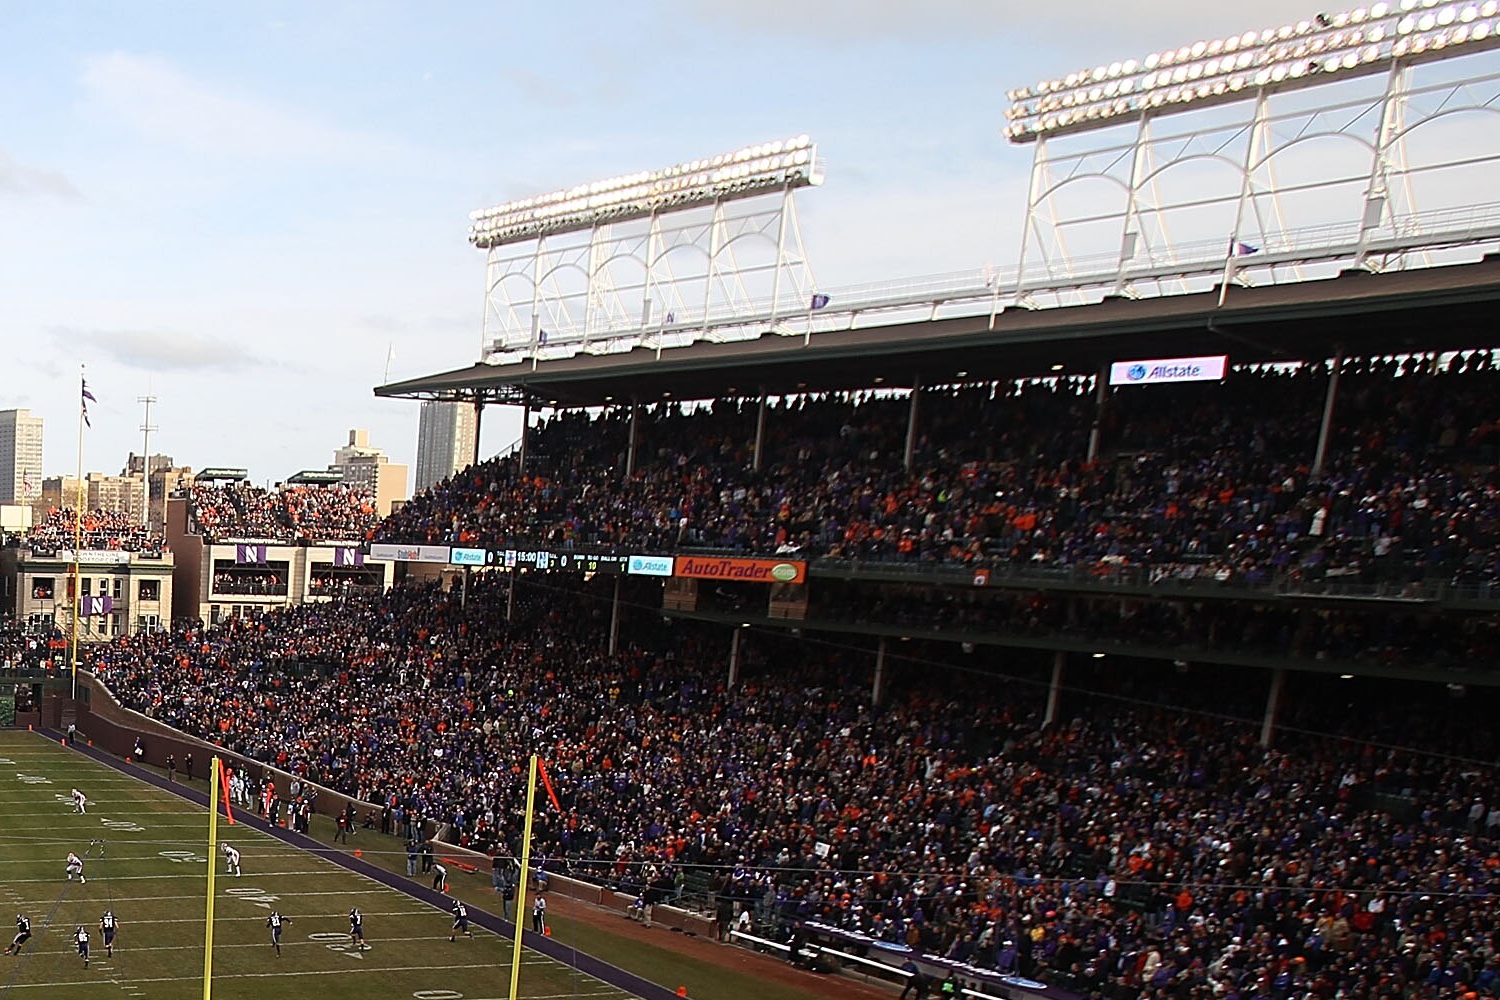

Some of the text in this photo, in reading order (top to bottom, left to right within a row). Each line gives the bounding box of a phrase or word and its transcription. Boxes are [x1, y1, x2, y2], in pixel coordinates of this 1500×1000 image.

[1148, 364, 1201, 379] Allstate
[245, 546, 257, 562] N
[343, 549, 355, 565] N
[487, 552, 493, 563] 0
[517, 551, 536, 563] 15:00
[560, 556, 567, 567] 0
[588, 561, 596, 570] 10
[91, 597, 103, 613] N
[103, 918, 113, 928] 94
[271, 917, 280, 926] 21
